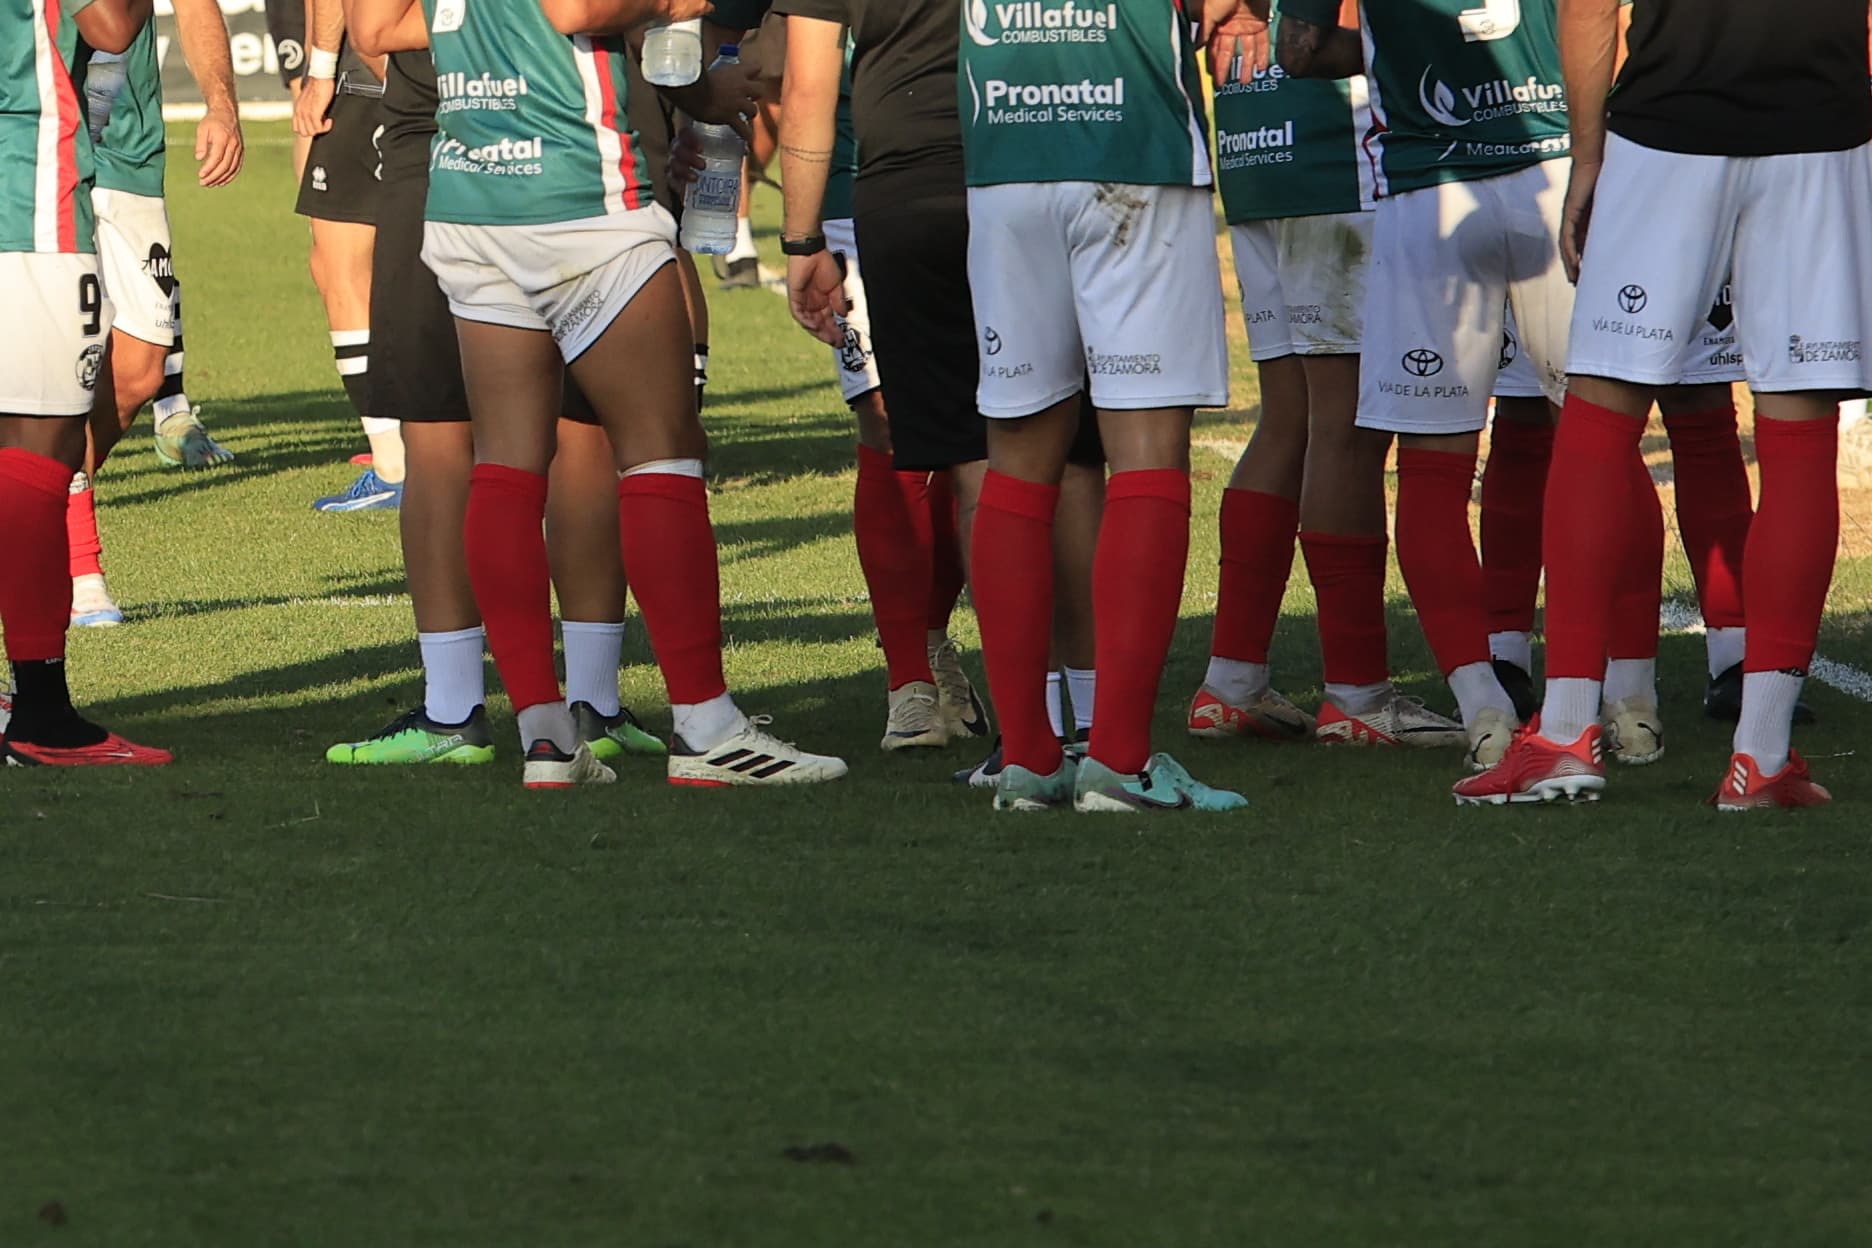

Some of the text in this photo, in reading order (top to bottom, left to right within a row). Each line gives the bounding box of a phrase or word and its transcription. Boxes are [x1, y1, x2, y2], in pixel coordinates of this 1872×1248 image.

[996, 1, 1117, 31] Villafuel
[1001, 28, 1107, 45] COMBUSTIBLES
[985, 77, 1124, 108] Pronatal
[988, 102, 1123, 125] Medical Services
[1218, 121, 1293, 154] Pronatal
[80, 272, 101, 336] 9
[1635, 326, 1674, 342] PLATA
[1434, 385, 1470, 398] PLATA
